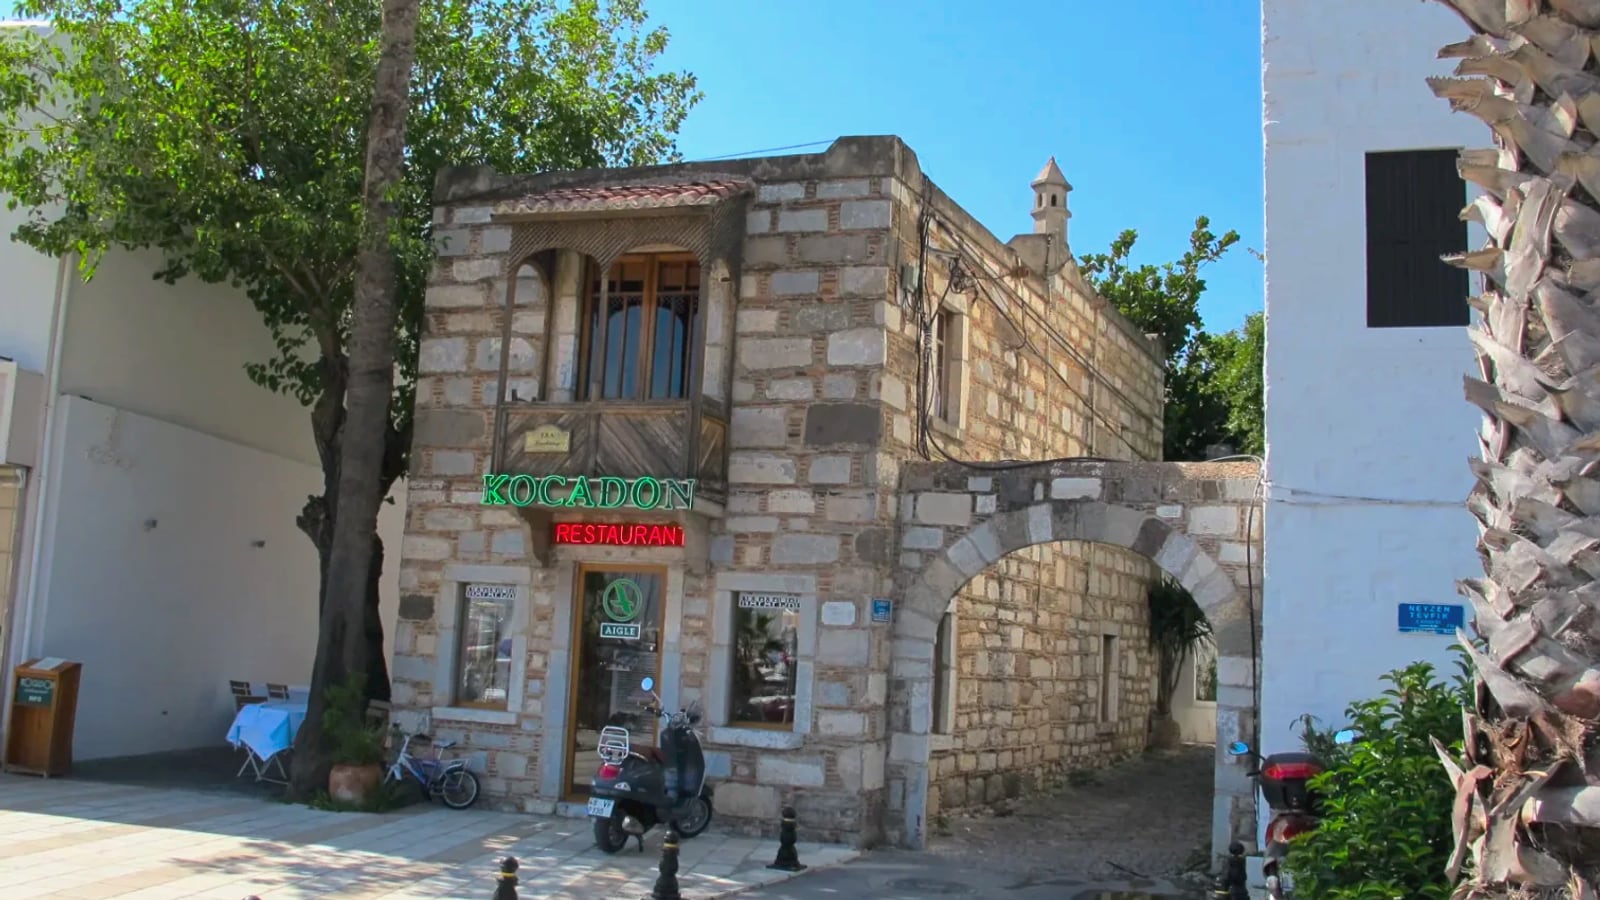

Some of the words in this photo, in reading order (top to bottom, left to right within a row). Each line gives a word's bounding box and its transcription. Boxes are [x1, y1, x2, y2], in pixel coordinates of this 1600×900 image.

[480, 474, 696, 510] KOCADON
[556, 524, 685, 546] RESTAURANT
[1408, 605, 1451, 613] NEYZEN
[605, 626, 636, 636] AIGLE
